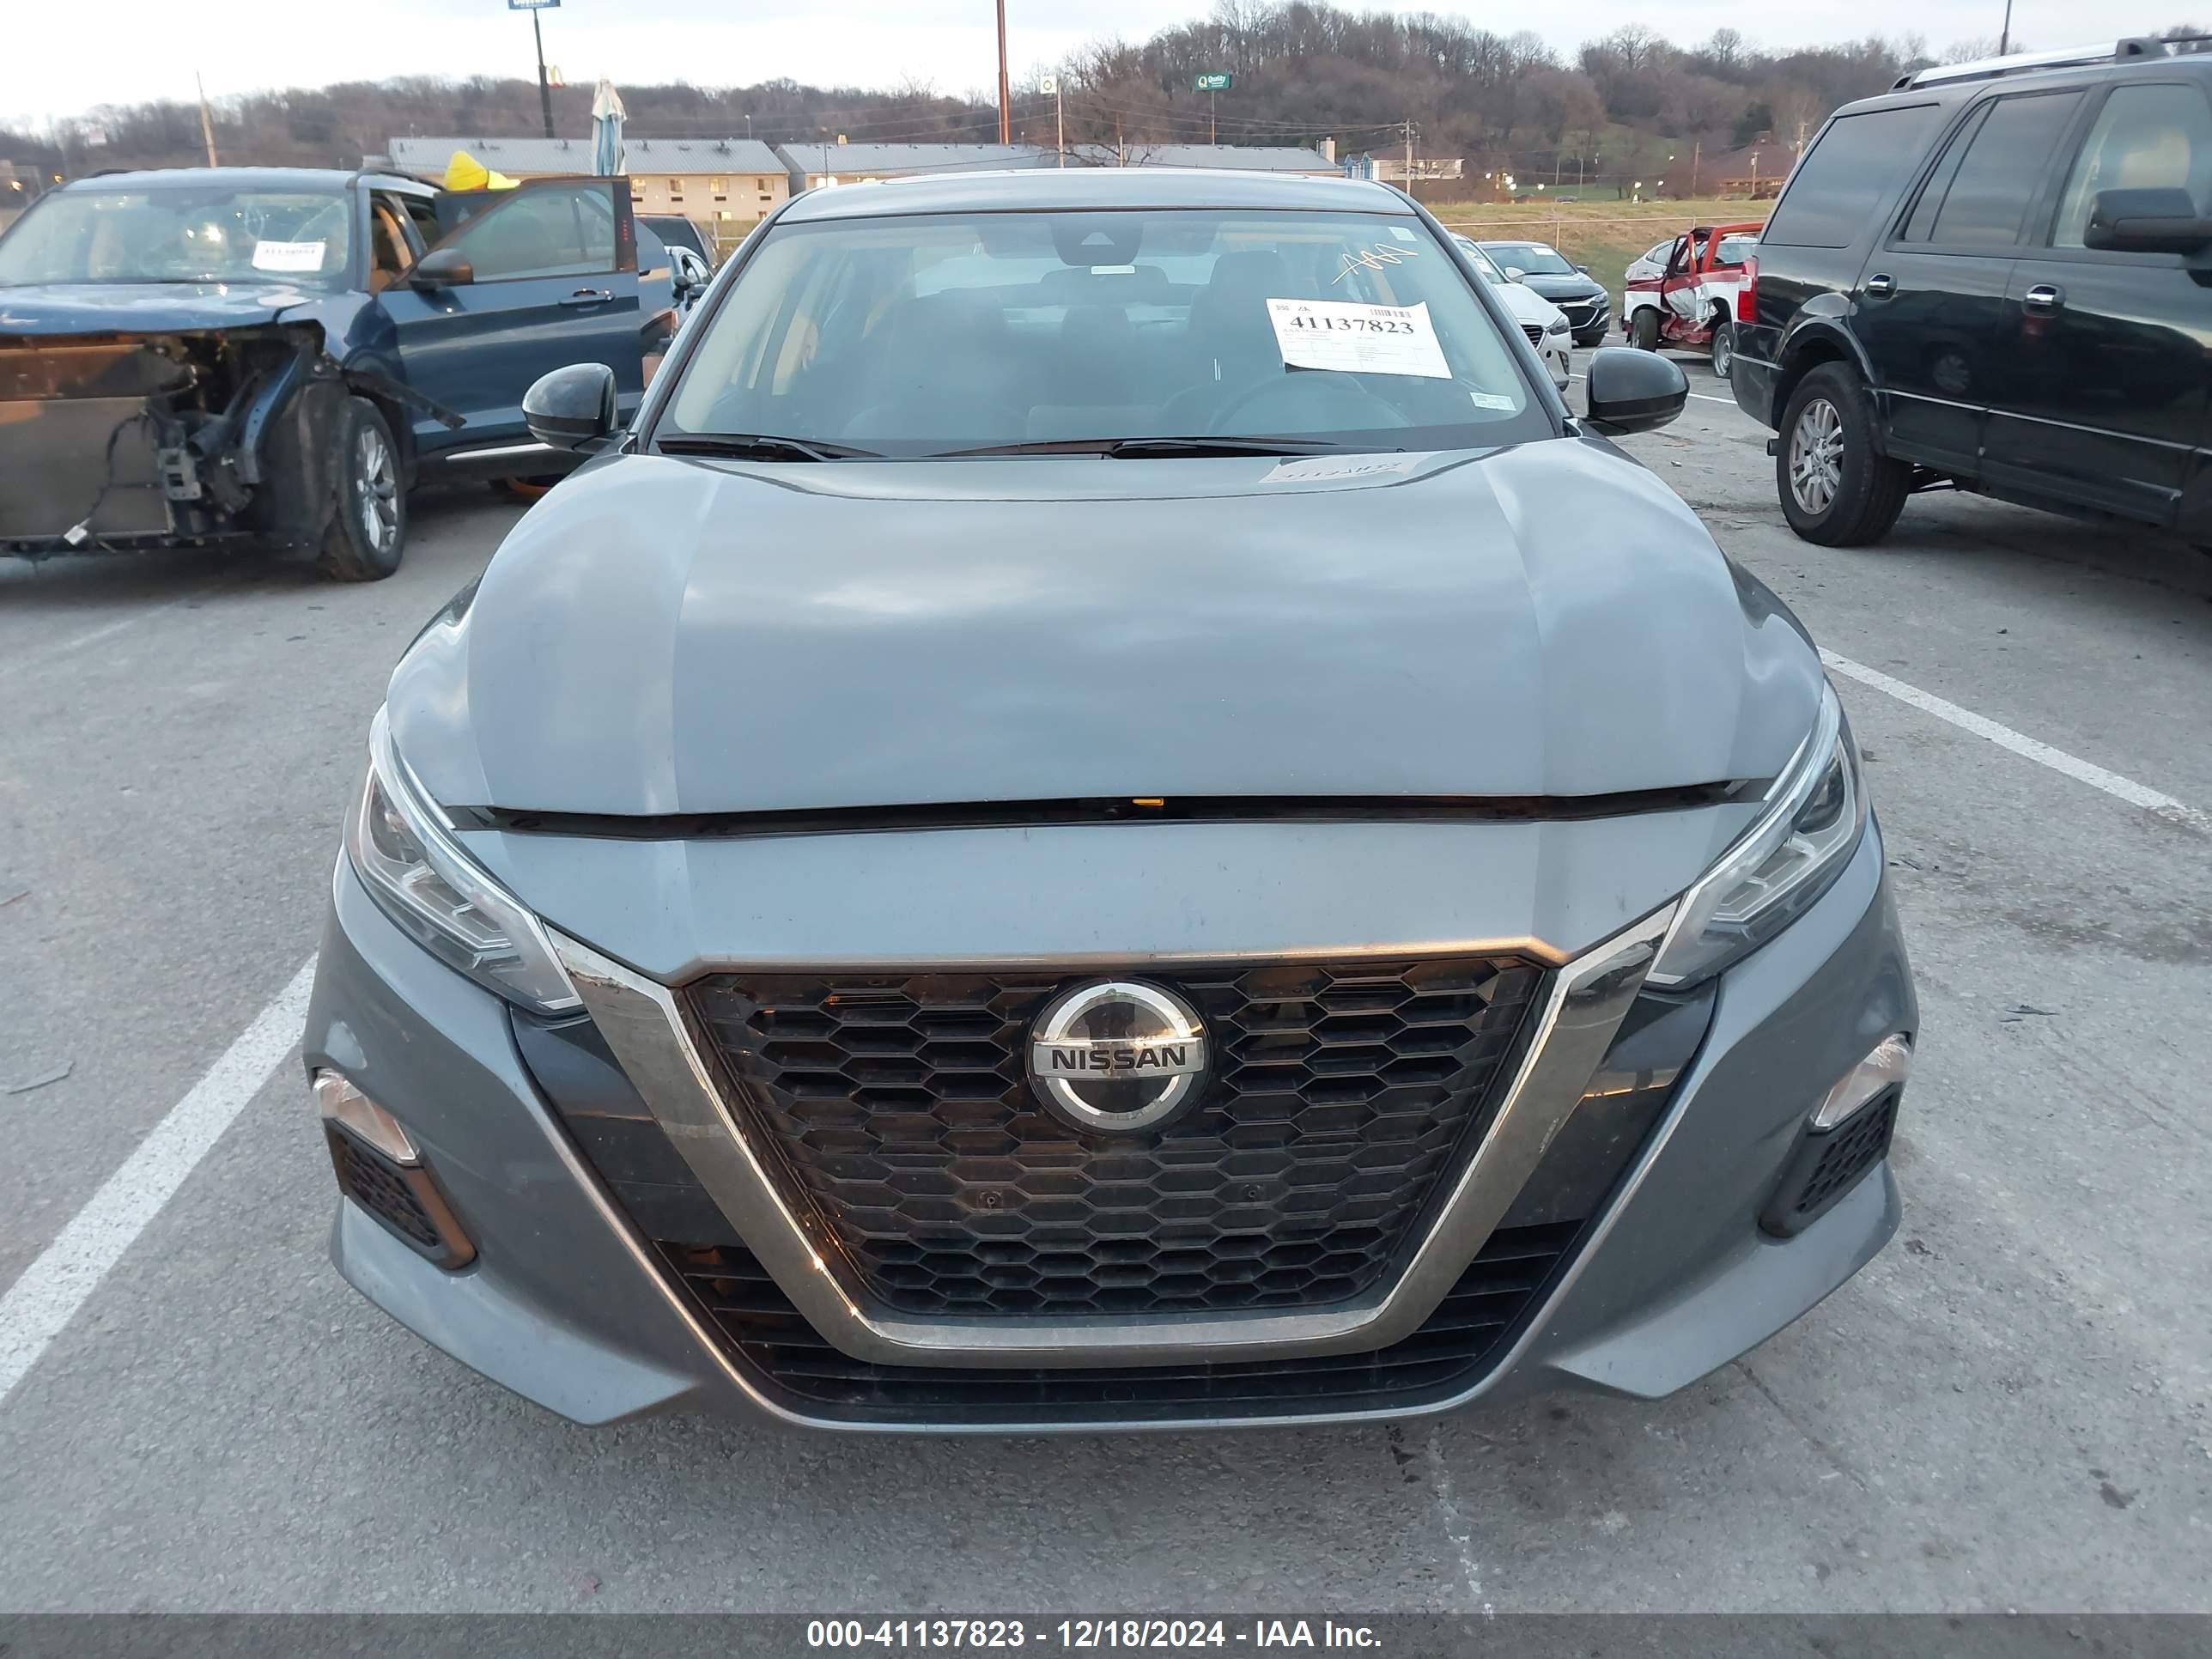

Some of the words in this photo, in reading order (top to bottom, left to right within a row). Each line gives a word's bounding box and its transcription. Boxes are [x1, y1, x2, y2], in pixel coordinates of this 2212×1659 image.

[1208, 75, 1226, 83] Quality
[1290, 316, 1414, 335] 41137823
[1052, 1046, 1186, 1070] NISSAN
